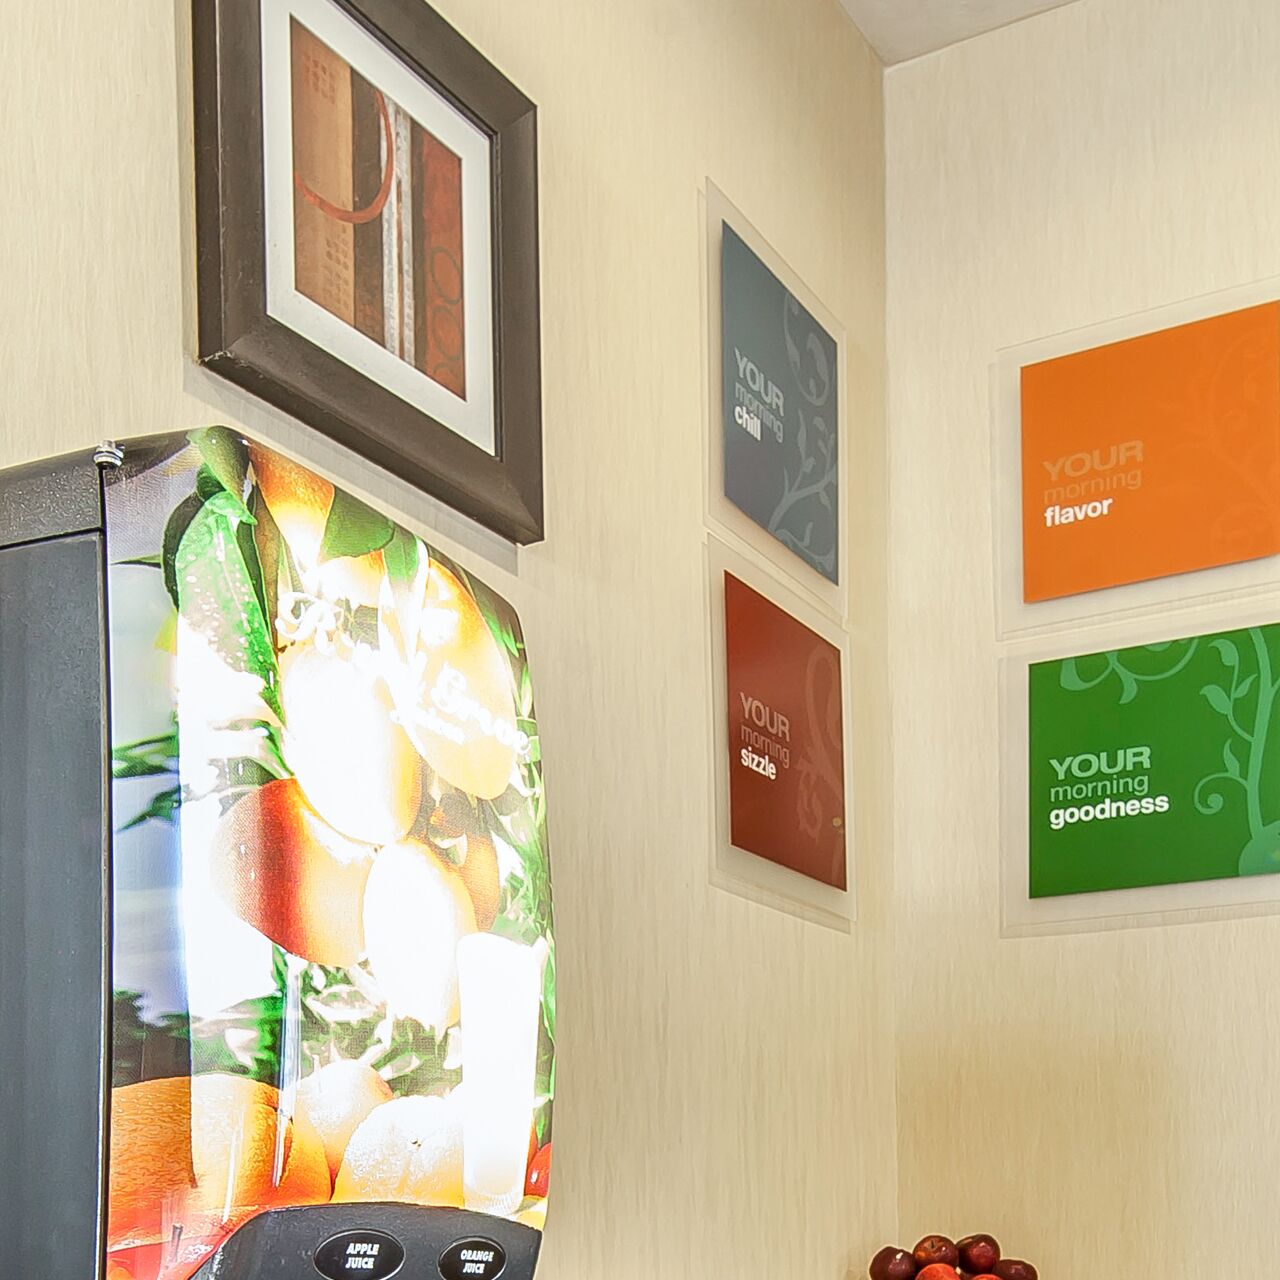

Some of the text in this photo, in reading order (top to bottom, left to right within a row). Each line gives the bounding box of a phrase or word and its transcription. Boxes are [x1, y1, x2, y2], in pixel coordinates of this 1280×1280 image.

[735, 347, 784, 416] YOUR
[734, 403, 761, 442] chill
[735, 382, 784, 443] morning
[1043, 440, 1144, 482] YOUR
[1044, 469, 1142, 504] morning
[1044, 498, 1113, 527] flavor
[740, 692, 790, 742] YOUR
[741, 724, 790, 769] morning
[741, 746, 776, 780] sizzle
[1049, 746, 1151, 780] YOUR
[1050, 775, 1148, 803] morning
[1049, 795, 1169, 829] goodness
[344, 1257, 375, 1269] JUICE
[345, 1243, 380, 1255] APPLE
[460, 1249, 494, 1262] ORANGE
[462, 1263, 486, 1274] JUICE
